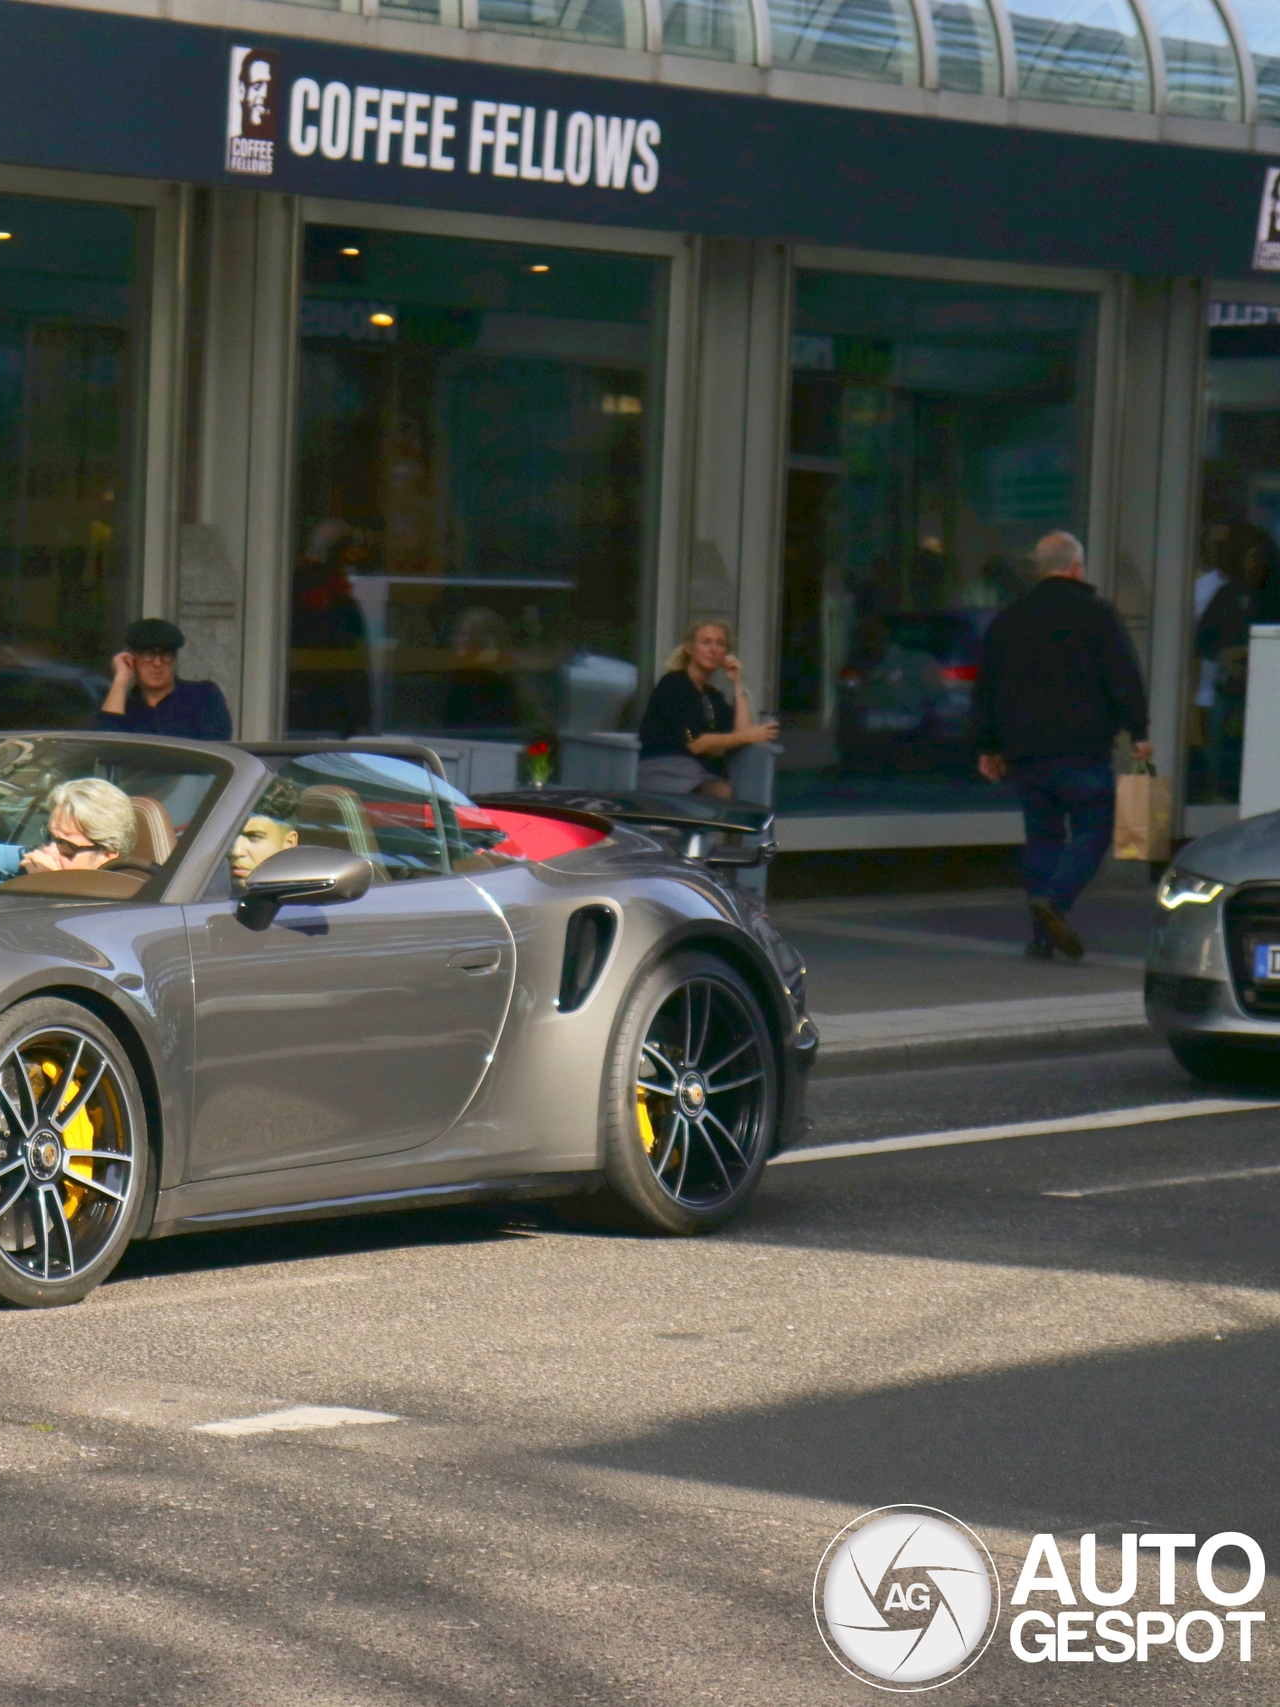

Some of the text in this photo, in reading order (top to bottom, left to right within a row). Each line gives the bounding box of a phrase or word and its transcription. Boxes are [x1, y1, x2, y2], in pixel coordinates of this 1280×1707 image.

[288, 77, 662, 193] COFFEE FELLOWS
[232, 138, 275, 159] COFFEE
[231, 157, 274, 173] FELLOWS
